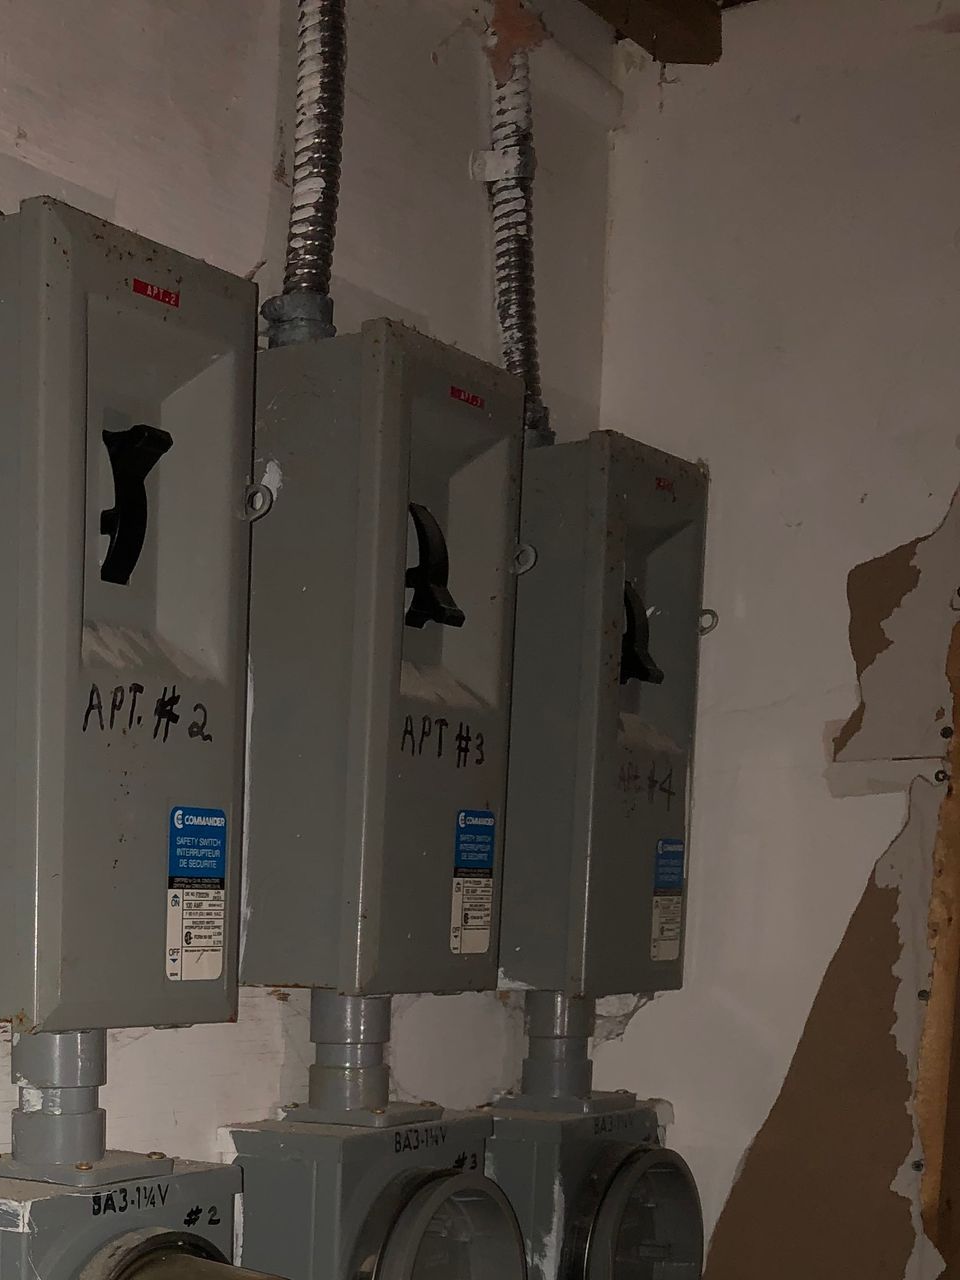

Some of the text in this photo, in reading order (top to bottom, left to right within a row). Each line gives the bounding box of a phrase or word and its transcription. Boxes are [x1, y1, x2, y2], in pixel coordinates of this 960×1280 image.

[82, 683, 213, 743] APT. #2
[401, 715, 485, 768] APT #3
[184, 815, 225, 827] COMMANDER
[176, 836, 198, 846] SAFETY
[170, 899, 180, 907] ON
[169, 948, 180, 956] OFF
[453, 1151, 478, 1170] #3
[184, 1205, 221, 1228] #2
